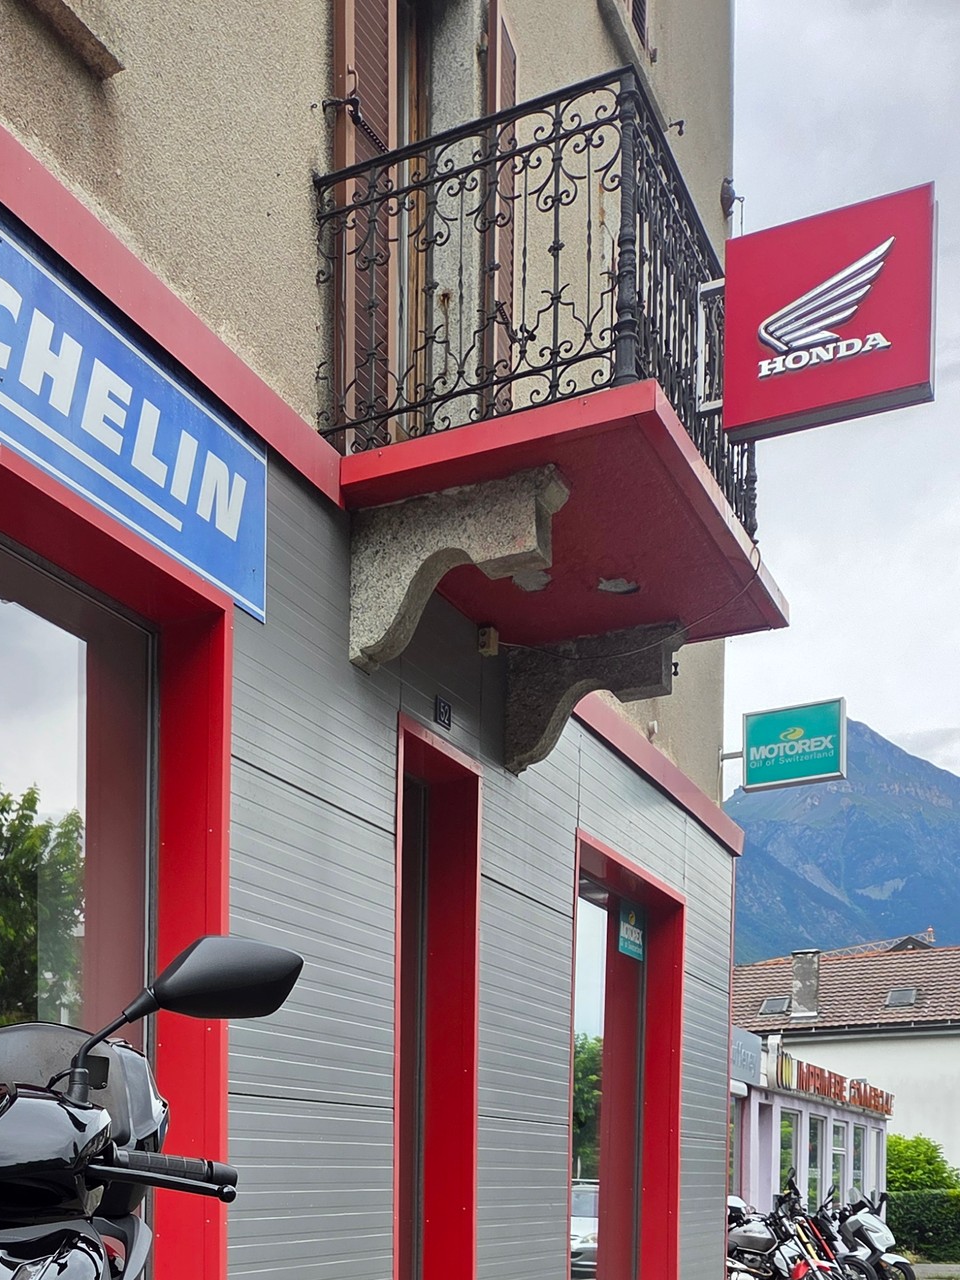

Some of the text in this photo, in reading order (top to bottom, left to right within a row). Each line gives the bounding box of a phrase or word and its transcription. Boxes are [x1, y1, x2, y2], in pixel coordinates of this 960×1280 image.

[757, 331, 892, 379] HONDA
[439, 702, 450, 724] 52
[749, 735, 835, 761] MOTOREX
[749, 750, 835, 769] Oil of Switzerland
